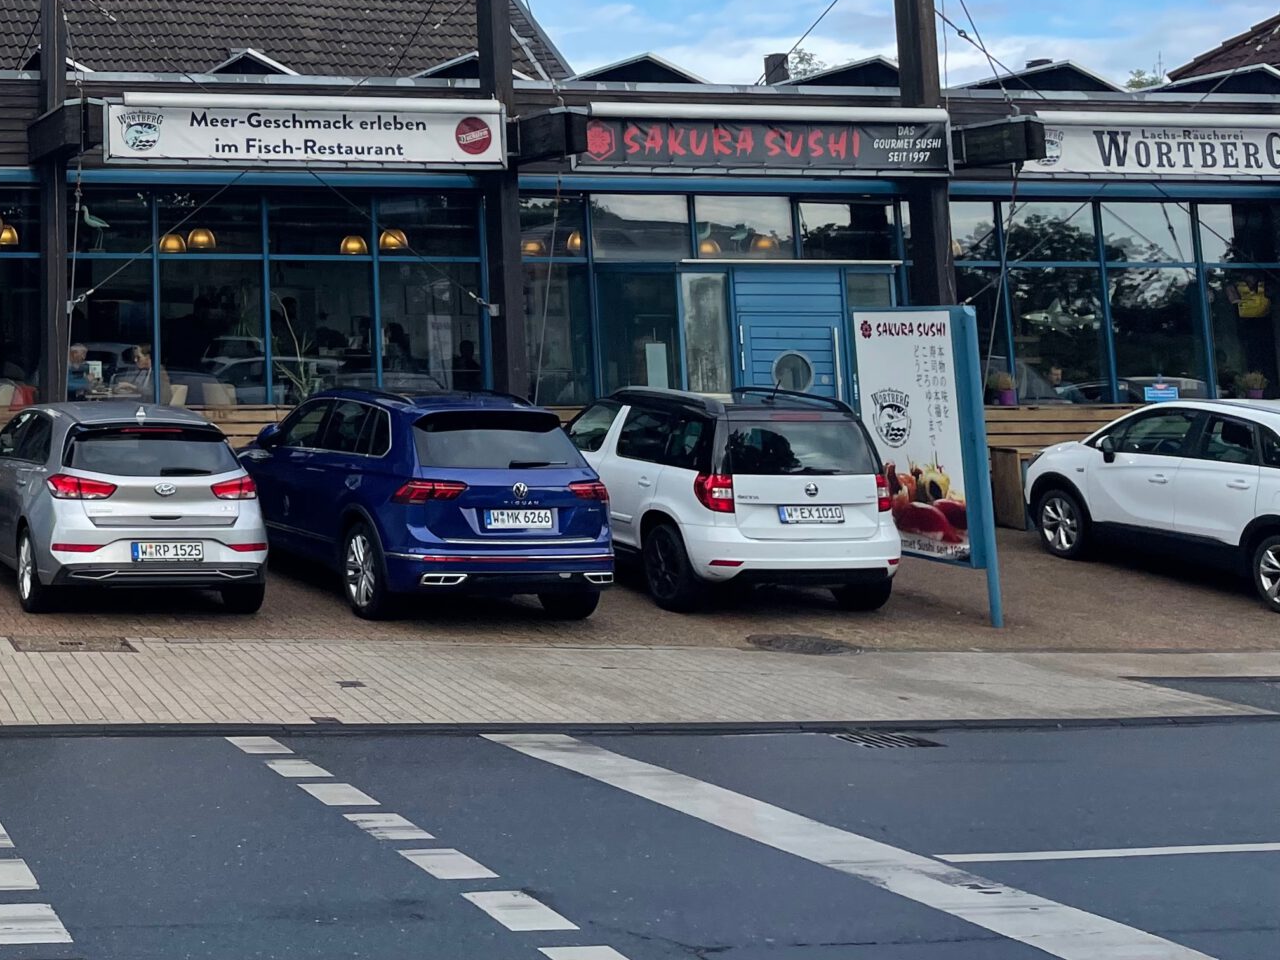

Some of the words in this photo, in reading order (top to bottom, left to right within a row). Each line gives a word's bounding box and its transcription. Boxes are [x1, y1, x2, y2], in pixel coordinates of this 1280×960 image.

[189, 111, 354, 130] Meer-Geschmack
[359, 114, 427, 131] erleben
[898, 126, 915, 136] DAS
[1141, 128, 1245, 141] Lachs-Räucherei
[214, 138, 239, 153] im
[245, 138, 404, 156] Fisch-Restaurant
[623, 125, 754, 158] SAKURA
[764, 127, 861, 160] SUSHI
[873, 138, 913, 149] GOURMET
[915, 138, 942, 149] SUSHI
[888, 150, 907, 162] SEIT
[908, 151, 931, 163] 1997
[876, 322, 914, 337] SAKURA
[917, 322, 946, 337] SUSHI
[506, 511, 521, 523] MK
[523, 511, 551, 524] 6266
[800, 508, 815, 519] EX
[816, 507, 842, 519] 1010
[155, 544, 170, 557] RP
[173, 544, 202, 557] 1525
